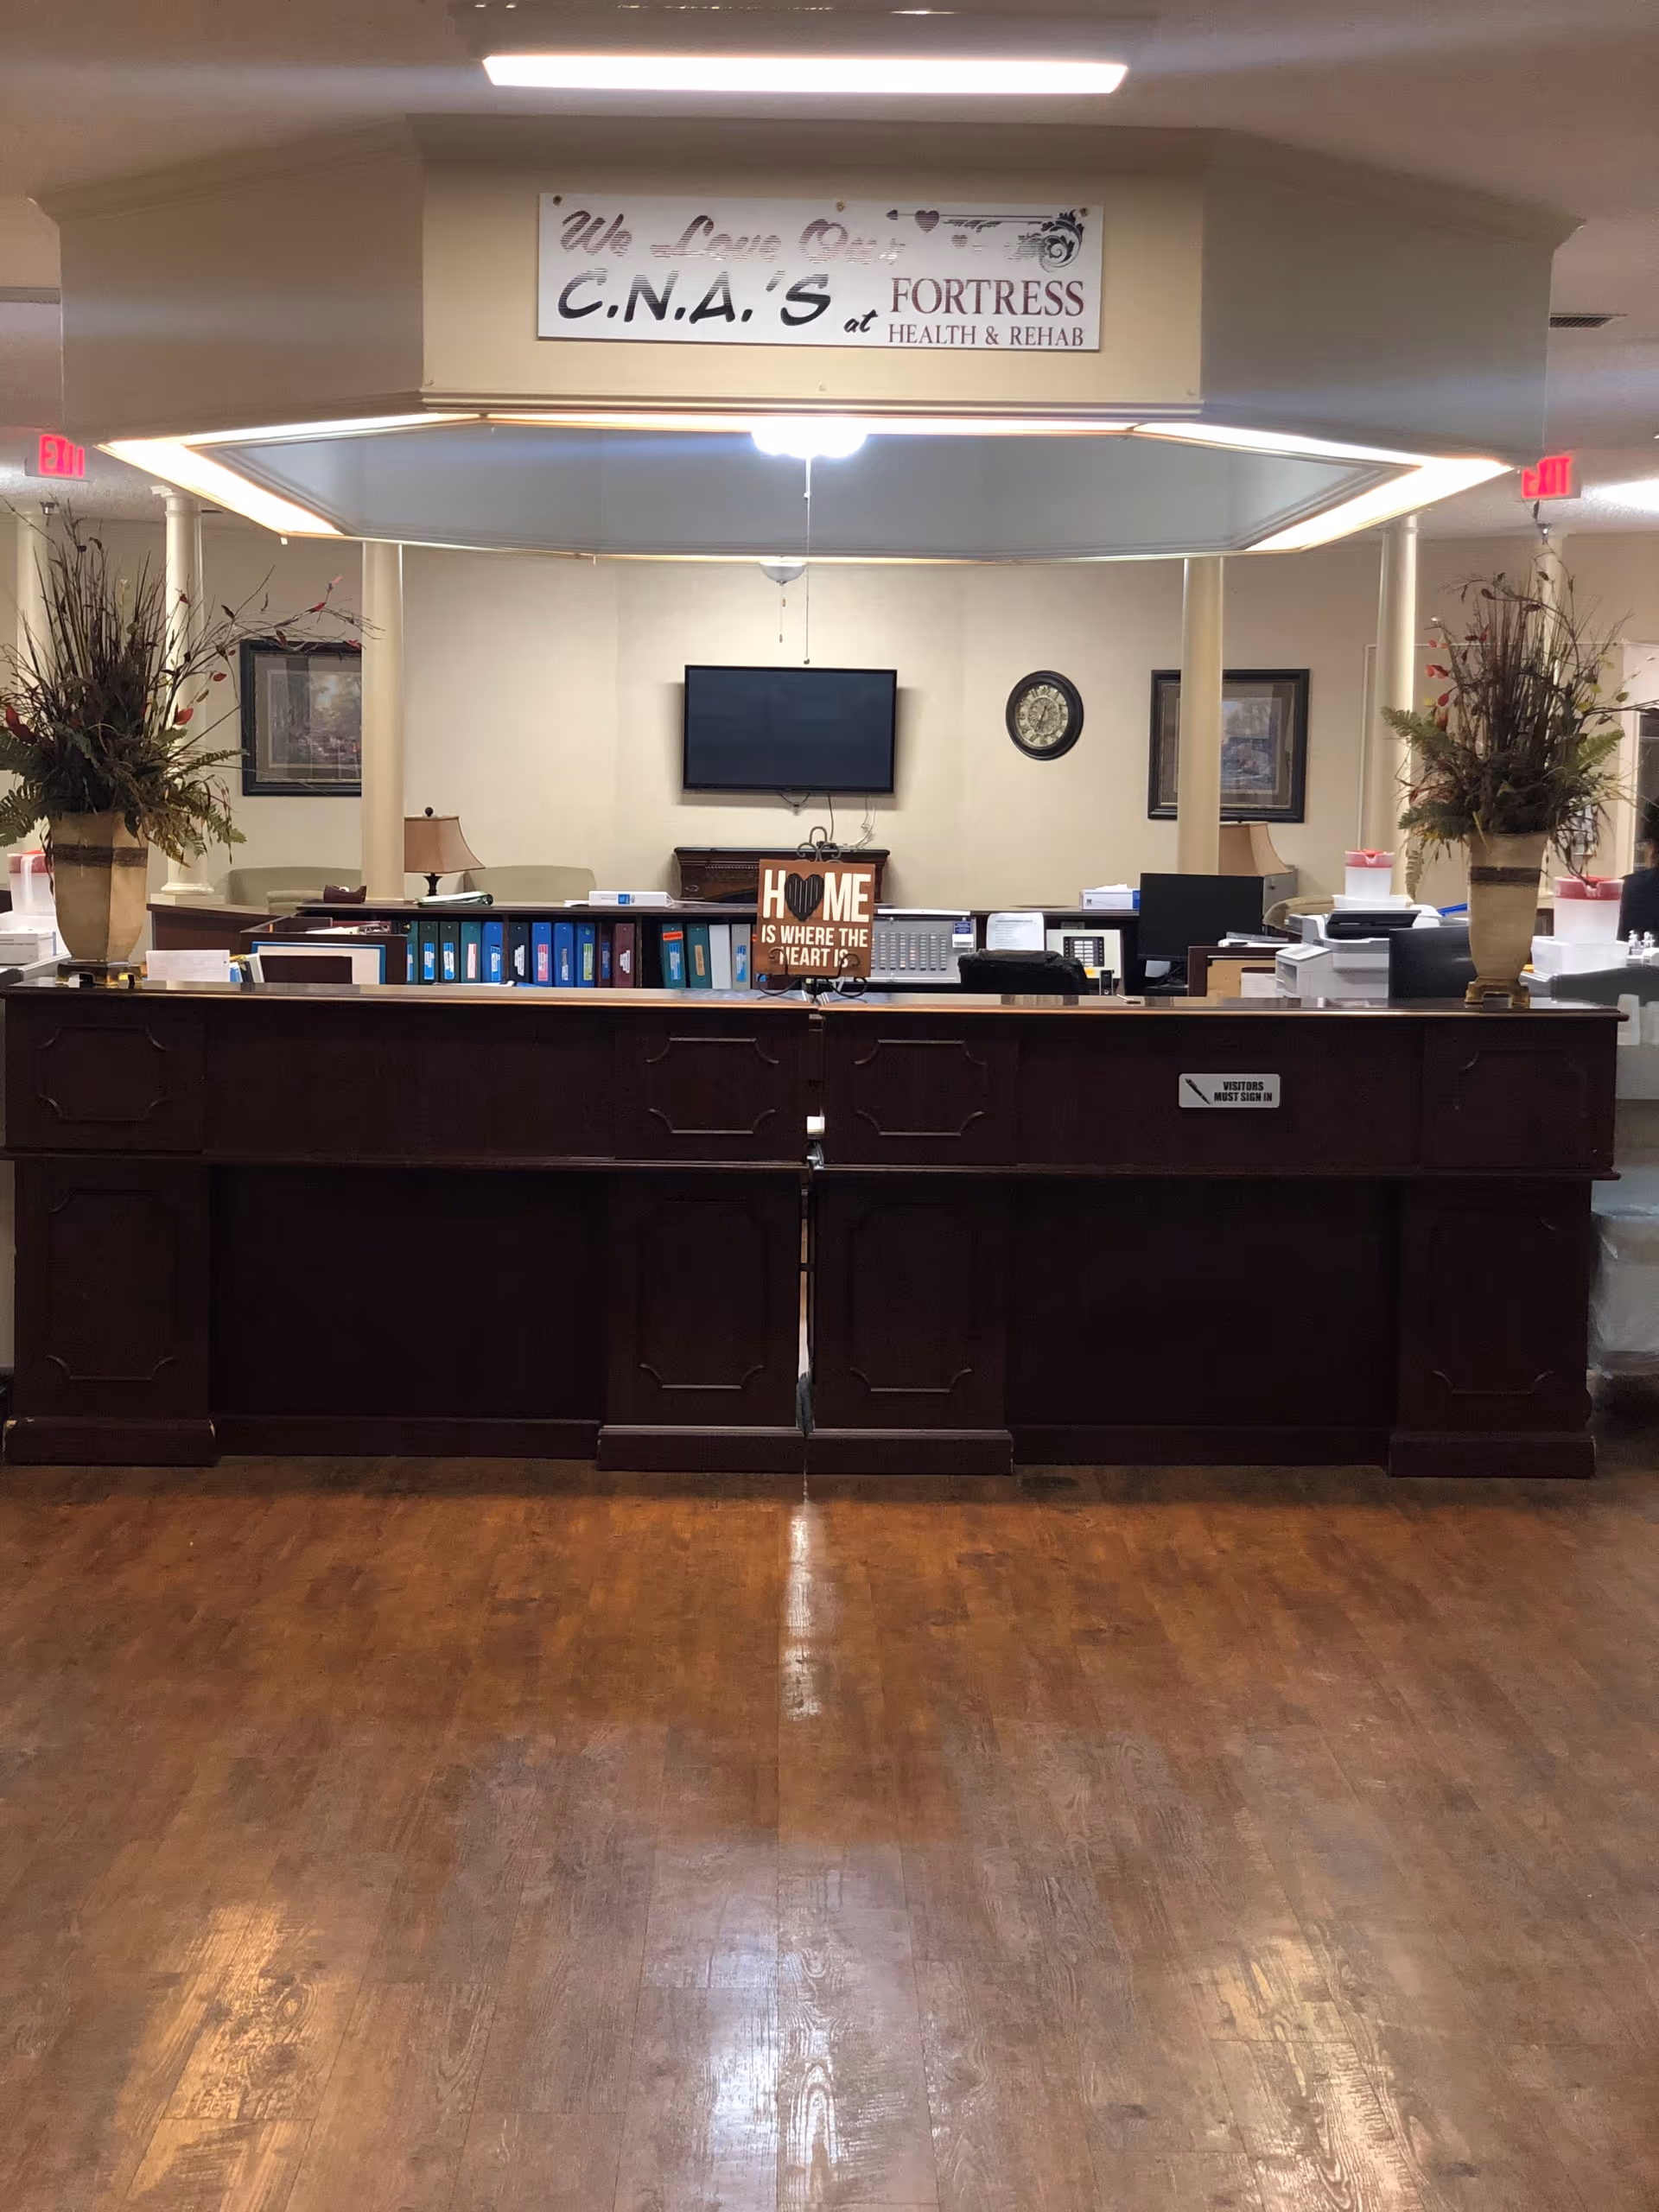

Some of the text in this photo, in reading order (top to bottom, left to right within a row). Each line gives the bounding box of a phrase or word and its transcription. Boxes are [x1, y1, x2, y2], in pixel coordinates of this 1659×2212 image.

[560, 210, 906, 265] We Love Our
[557, 268, 879, 334] C.N.A.'S at
[890, 277, 1084, 316] FORTRESS
[888, 323, 1084, 347] HEALTH & REHAB
[761, 924, 868, 948] IS WHERE THE
[779, 946, 830, 967] HEART
[834, 949, 849, 969] IS
[1213, 1091, 1273, 1102] MUST SIGN IN
[1223, 1081, 1264, 1091] VISITORS
